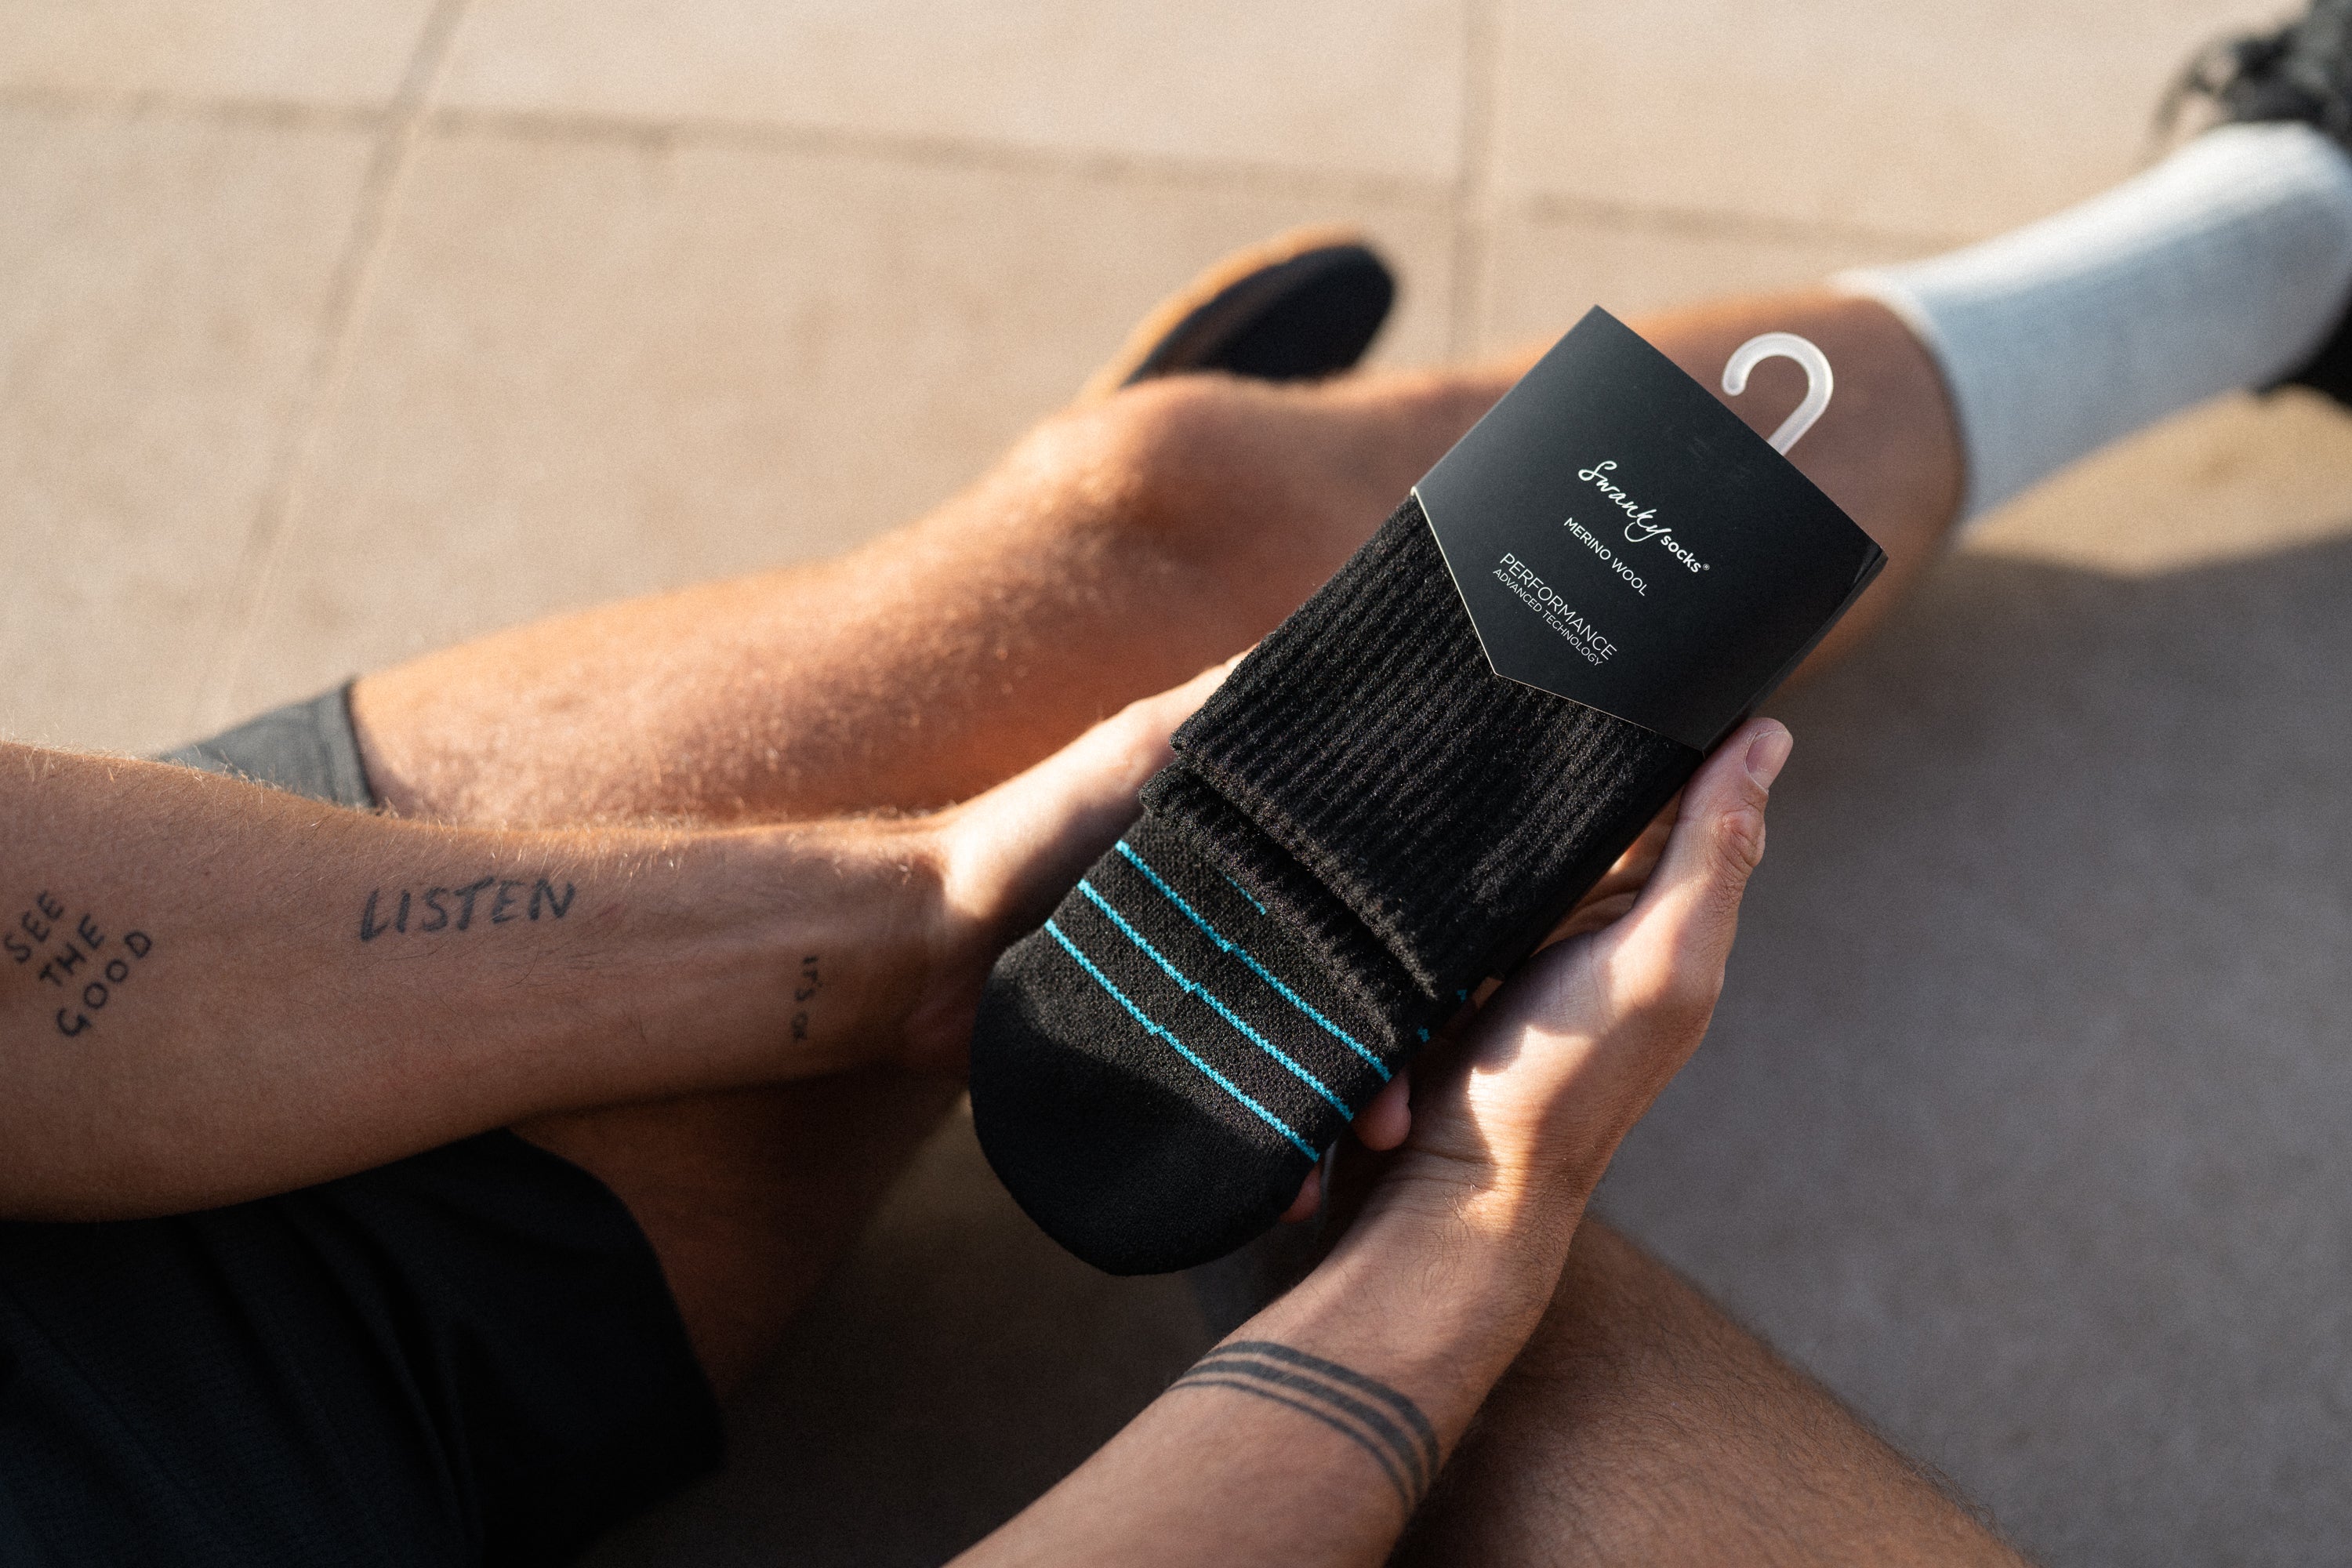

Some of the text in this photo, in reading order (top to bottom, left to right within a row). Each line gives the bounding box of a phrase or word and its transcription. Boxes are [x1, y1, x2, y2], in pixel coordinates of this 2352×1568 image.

[1578, 460, 1671, 542] Swanky
[1563, 517, 1647, 597] MERINO WOOL
[1492, 568, 1603, 666] ADVANCED TECHNOLOGY
[1500, 553, 1617, 660] PERFORMANCE
[3, 889, 64, 964] SEE
[360, 875, 576, 942] LISTEN
[38, 913, 105, 986] THE
[56, 929, 153, 1036] GOOD
